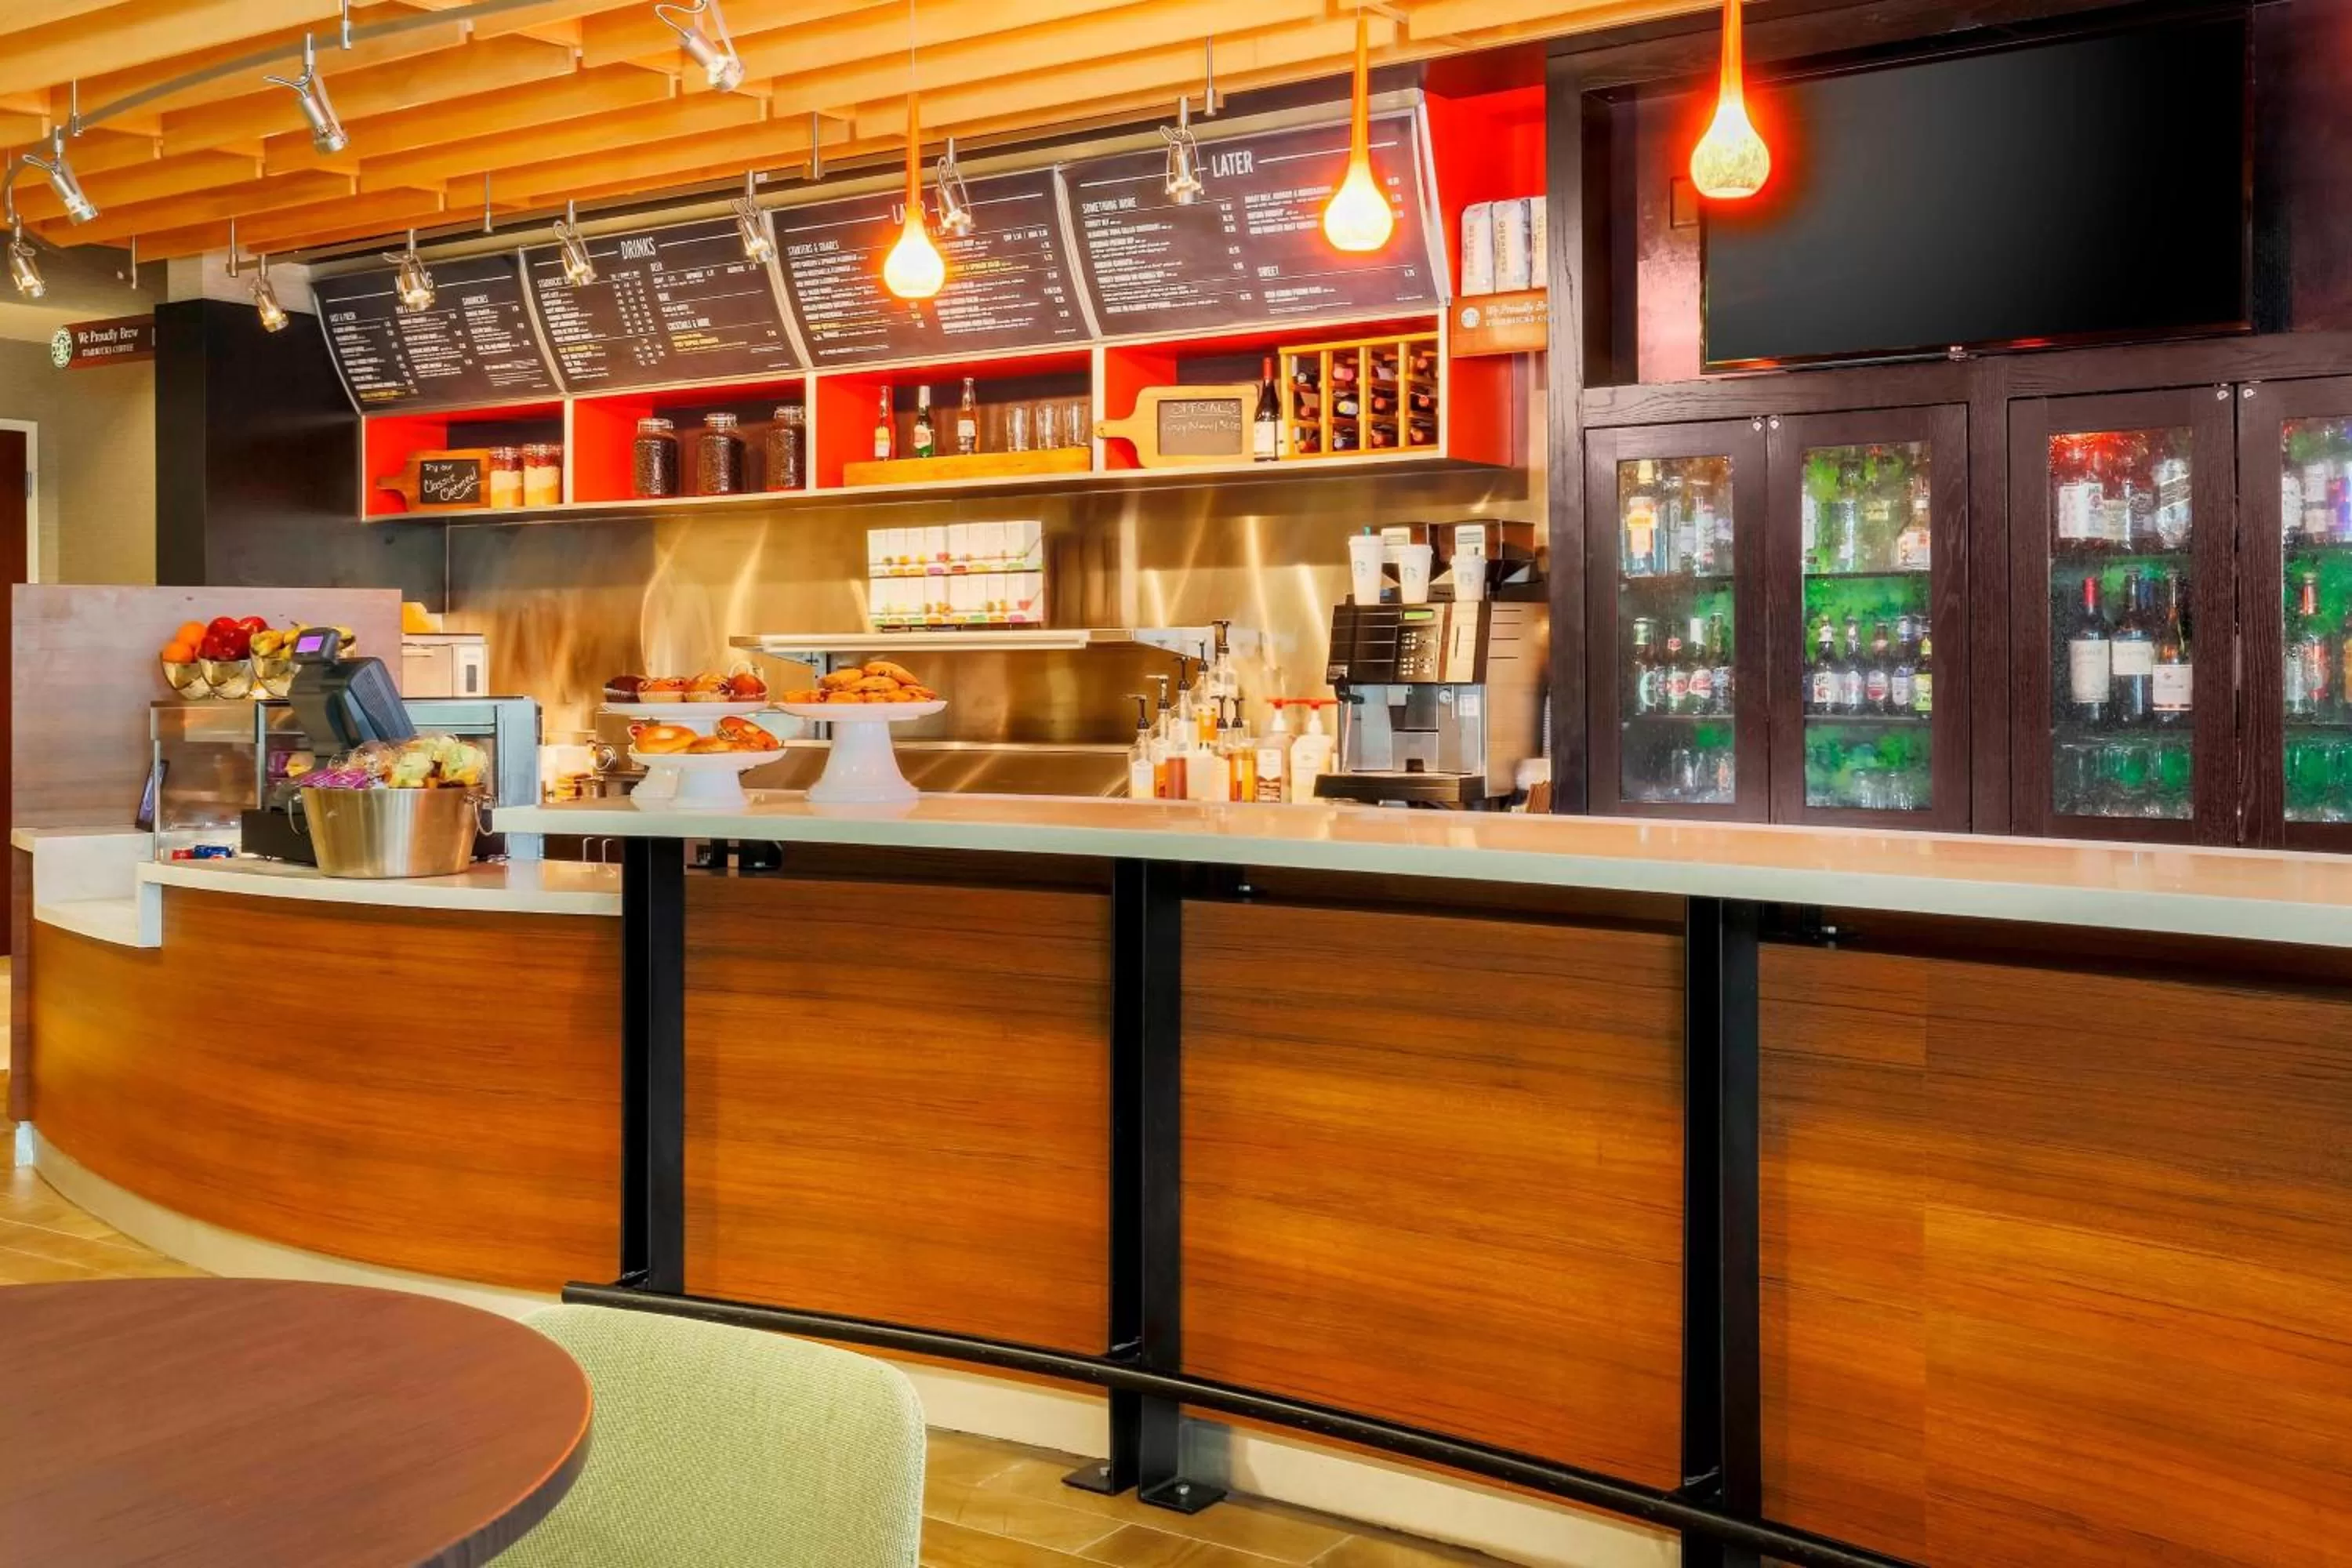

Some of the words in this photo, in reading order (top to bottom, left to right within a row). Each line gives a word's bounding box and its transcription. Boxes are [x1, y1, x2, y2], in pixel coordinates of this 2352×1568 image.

[1212, 151, 1253, 178] LATER
[620, 236, 656, 259] DRINKS
[78, 332, 89, 344] We
[90, 329, 118, 343] Proudly
[120, 327, 139, 339] Brew
